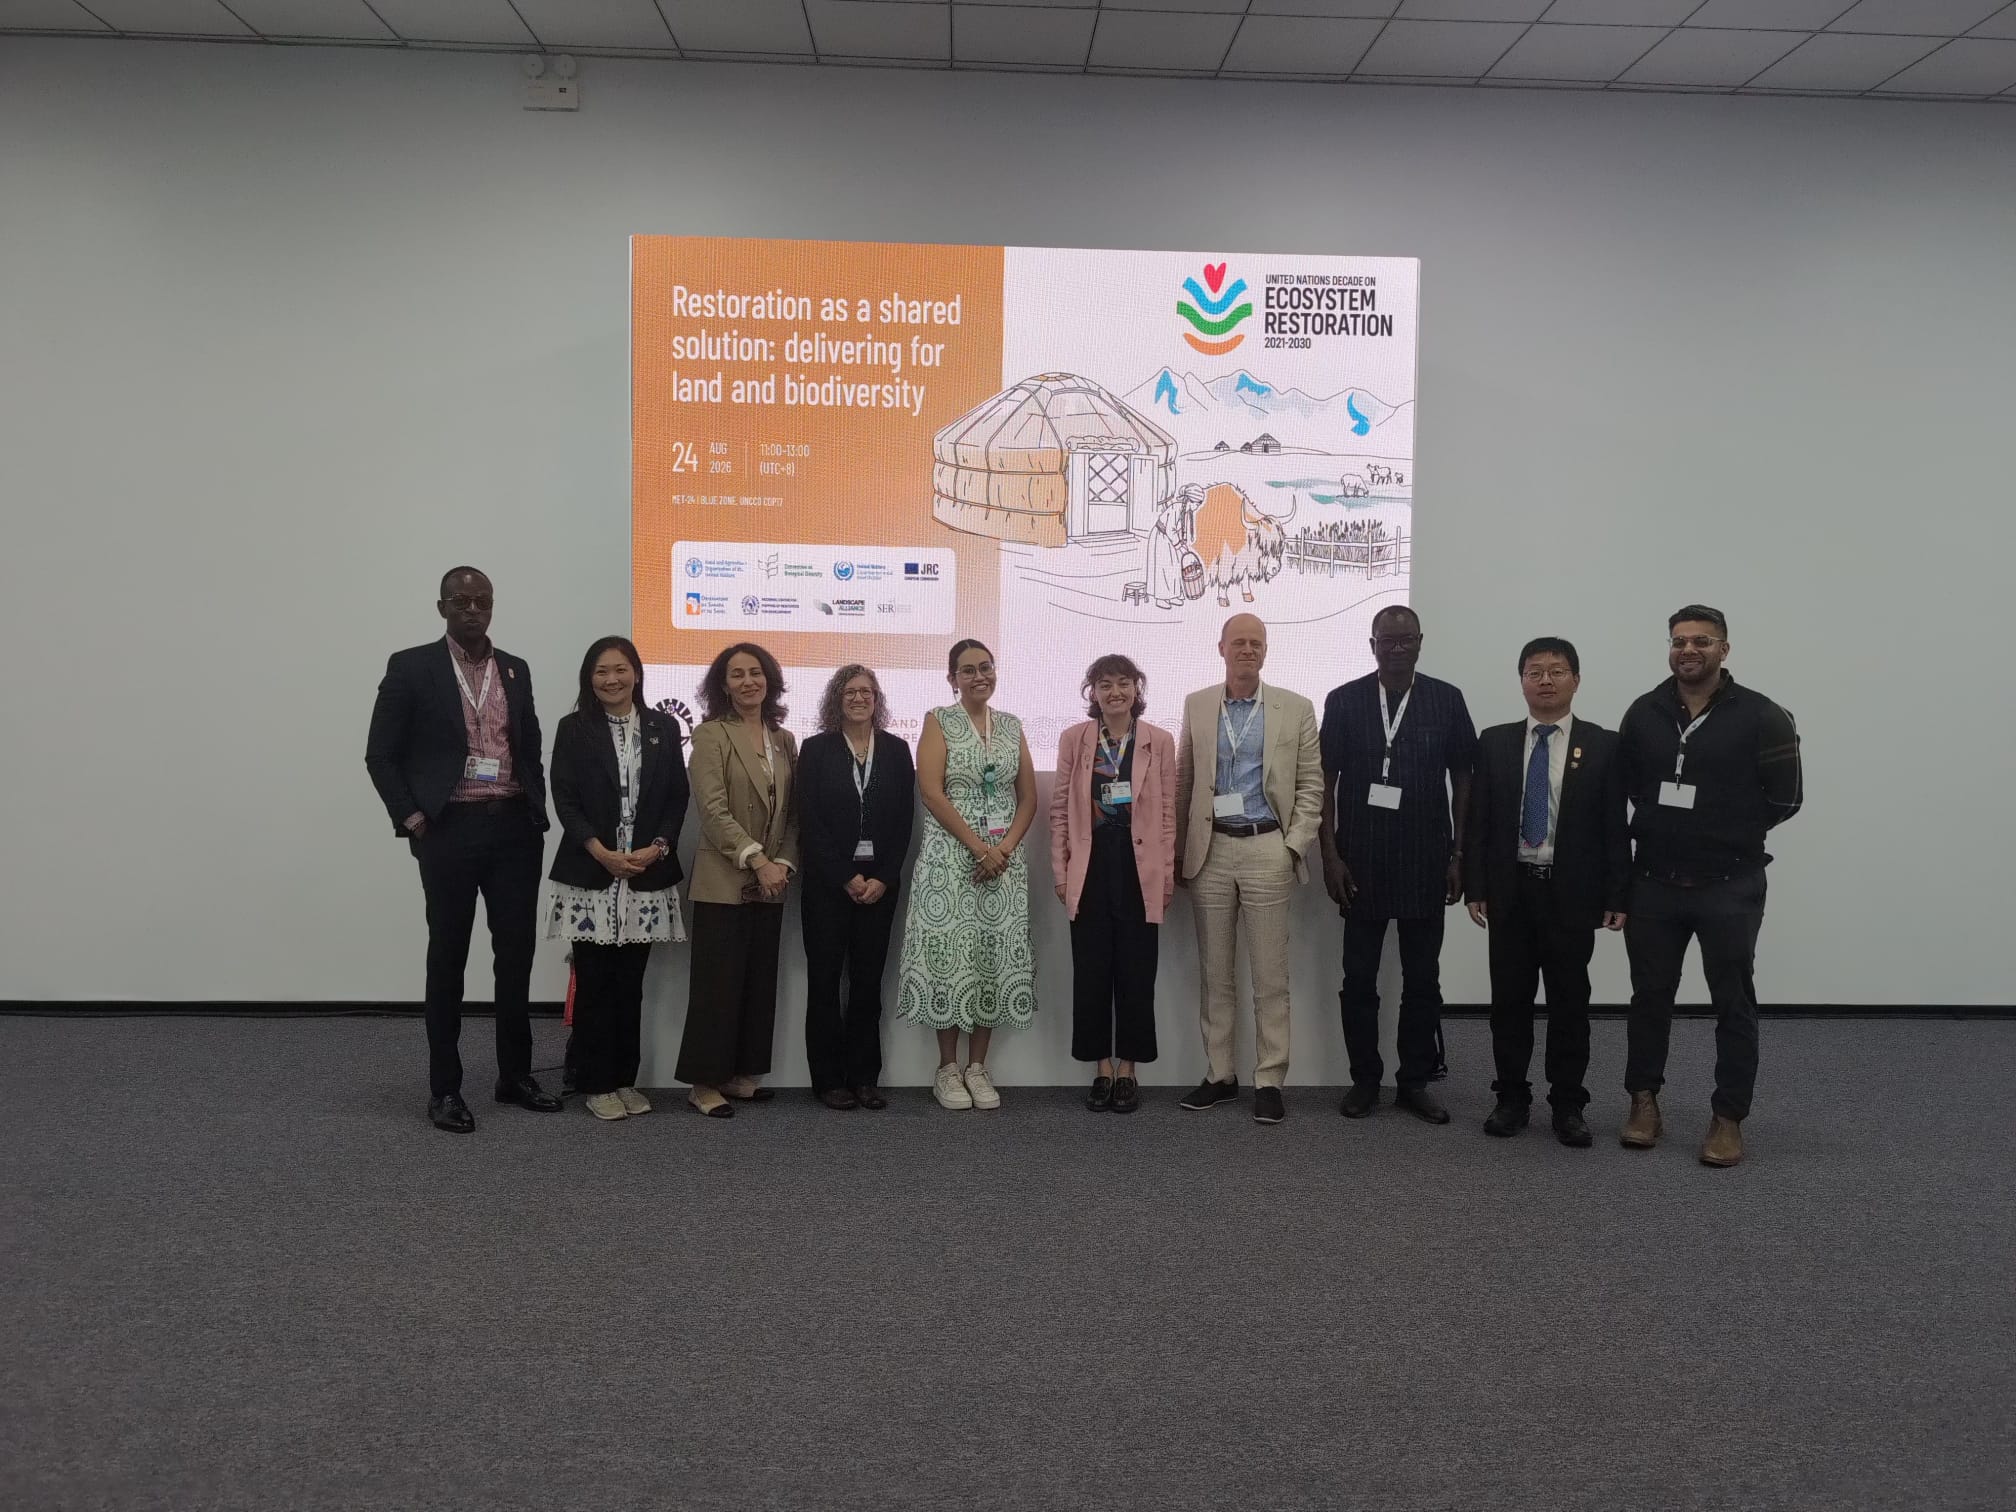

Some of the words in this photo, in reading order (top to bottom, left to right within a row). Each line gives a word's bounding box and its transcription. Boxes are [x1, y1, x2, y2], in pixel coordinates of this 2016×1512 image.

[1265, 274, 1294, 285] UNITED
[1296, 275, 1331, 286] NATIONS
[1332, 276, 1363, 286] DECADE
[1364, 277, 1376, 287] ON
[672, 285, 812, 321] Restoration
[820, 297, 848, 322] as
[857, 299, 871, 323] a
[879, 292, 961, 326] shared
[1265, 287, 1376, 311] ECOSYSTEM
[1264, 312, 1393, 337] RESTORATION
[672, 329, 775, 362] solution:
[784, 331, 901, 373] delivering
[911, 335, 945, 367] for
[1264, 336, 1312, 350] 2021-2030
[672, 371, 722, 404] land
[731, 374, 776, 405] and
[785, 374, 925, 417] biodiversity
[671, 441, 699, 473] 24
[709, 442, 729, 455] AUG
[709, 461, 732, 474] 2026
[920, 563, 939, 575] JRC
[877, 603, 894, 613] SER
